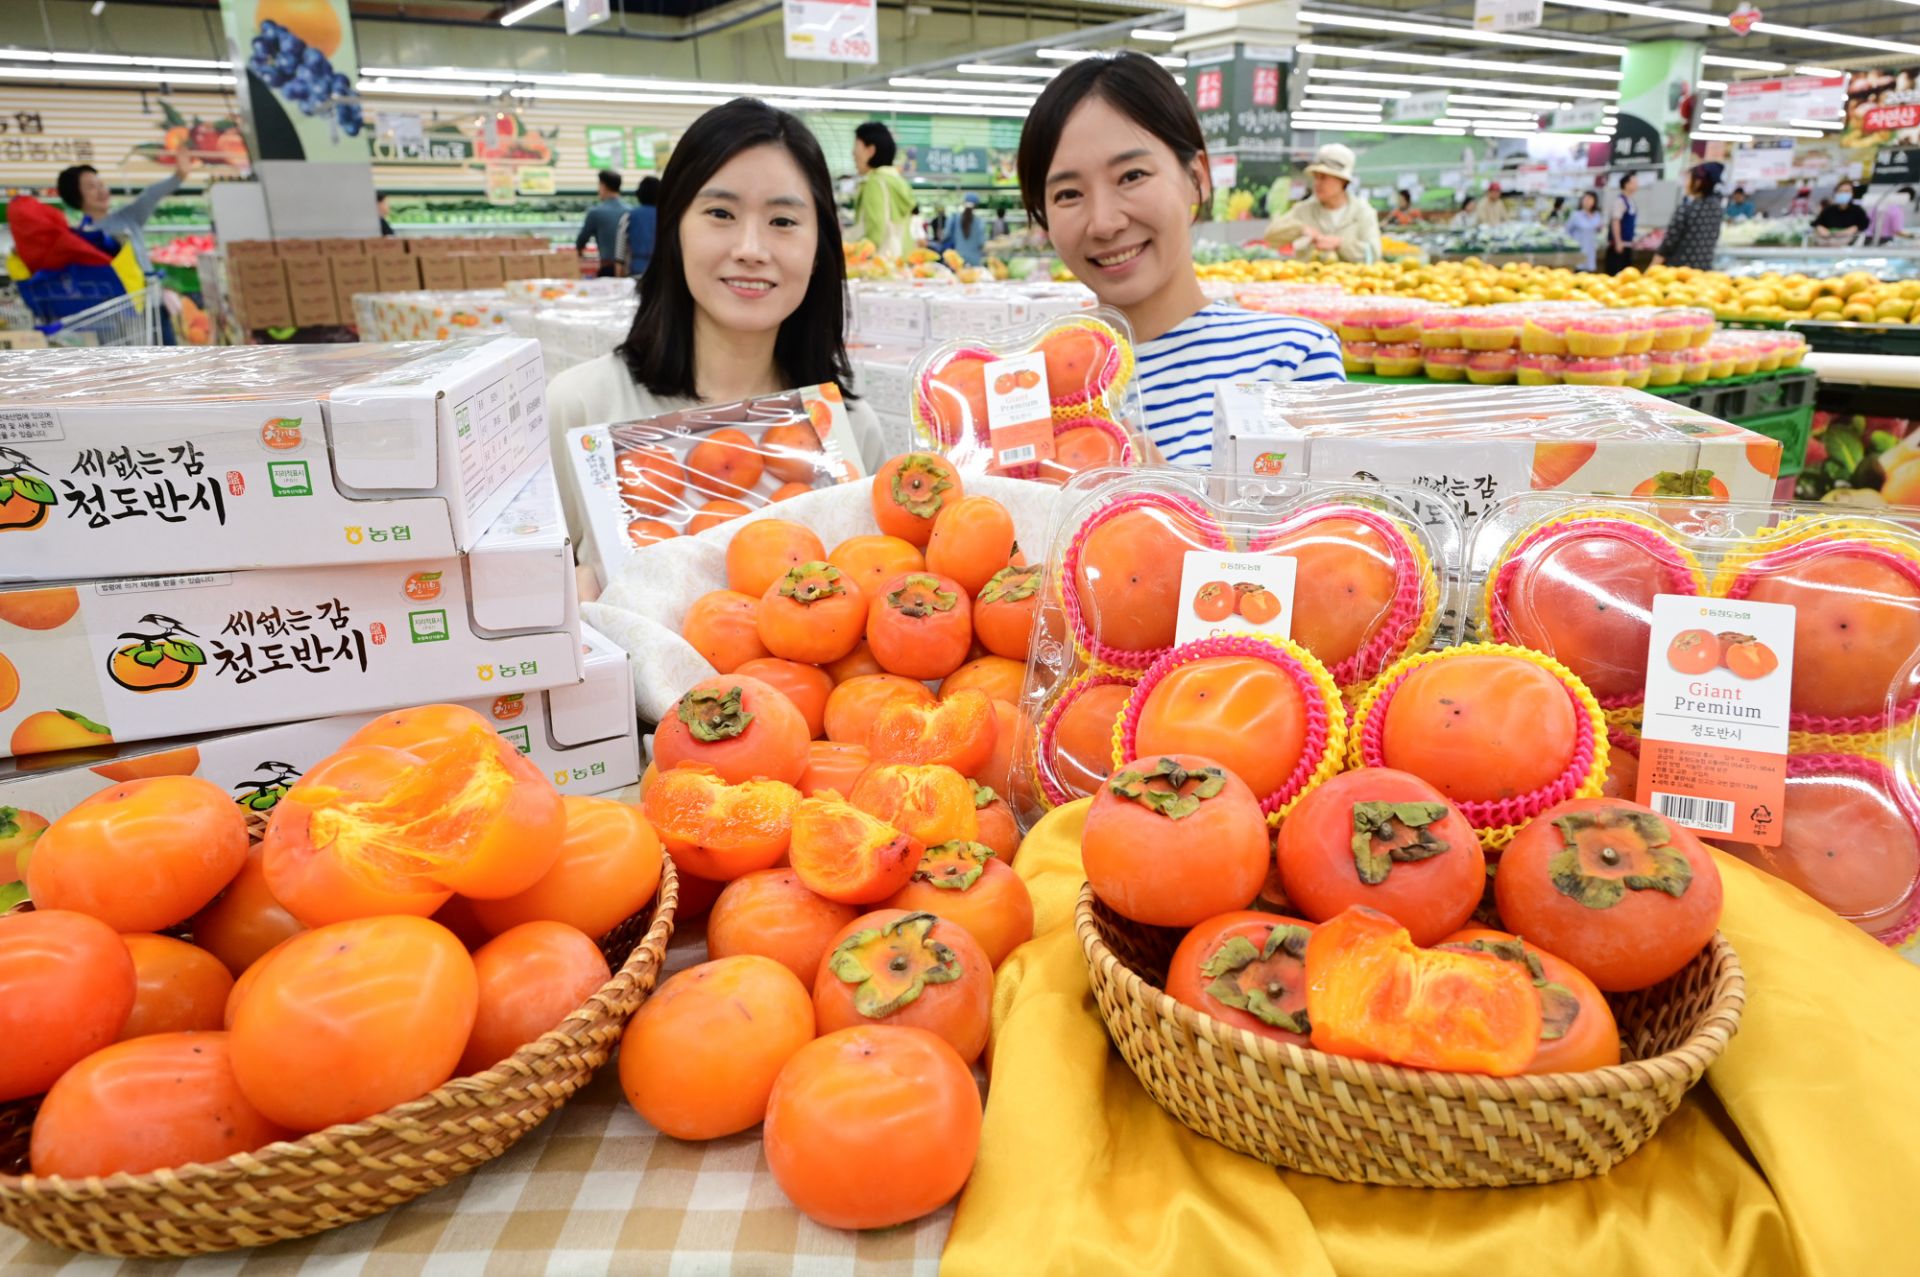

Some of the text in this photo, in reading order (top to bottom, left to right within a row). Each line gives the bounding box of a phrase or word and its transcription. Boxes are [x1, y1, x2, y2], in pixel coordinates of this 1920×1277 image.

[71, 440, 204, 481] 씨없는 감
[1474, 474, 1498, 499] 감
[59, 477, 225, 529] 청도반시
[368, 525, 411, 542] 농협
[221, 598, 350, 638] 씨없는 감
[210, 629, 368, 684] 청도반시
[499, 660, 538, 678] 농협
[1688, 682, 1742, 701] Giant
[1674, 696, 1762, 719] Premium
[1690, 723, 1742, 741] 청도반시
[573, 762, 605, 780] 농협
